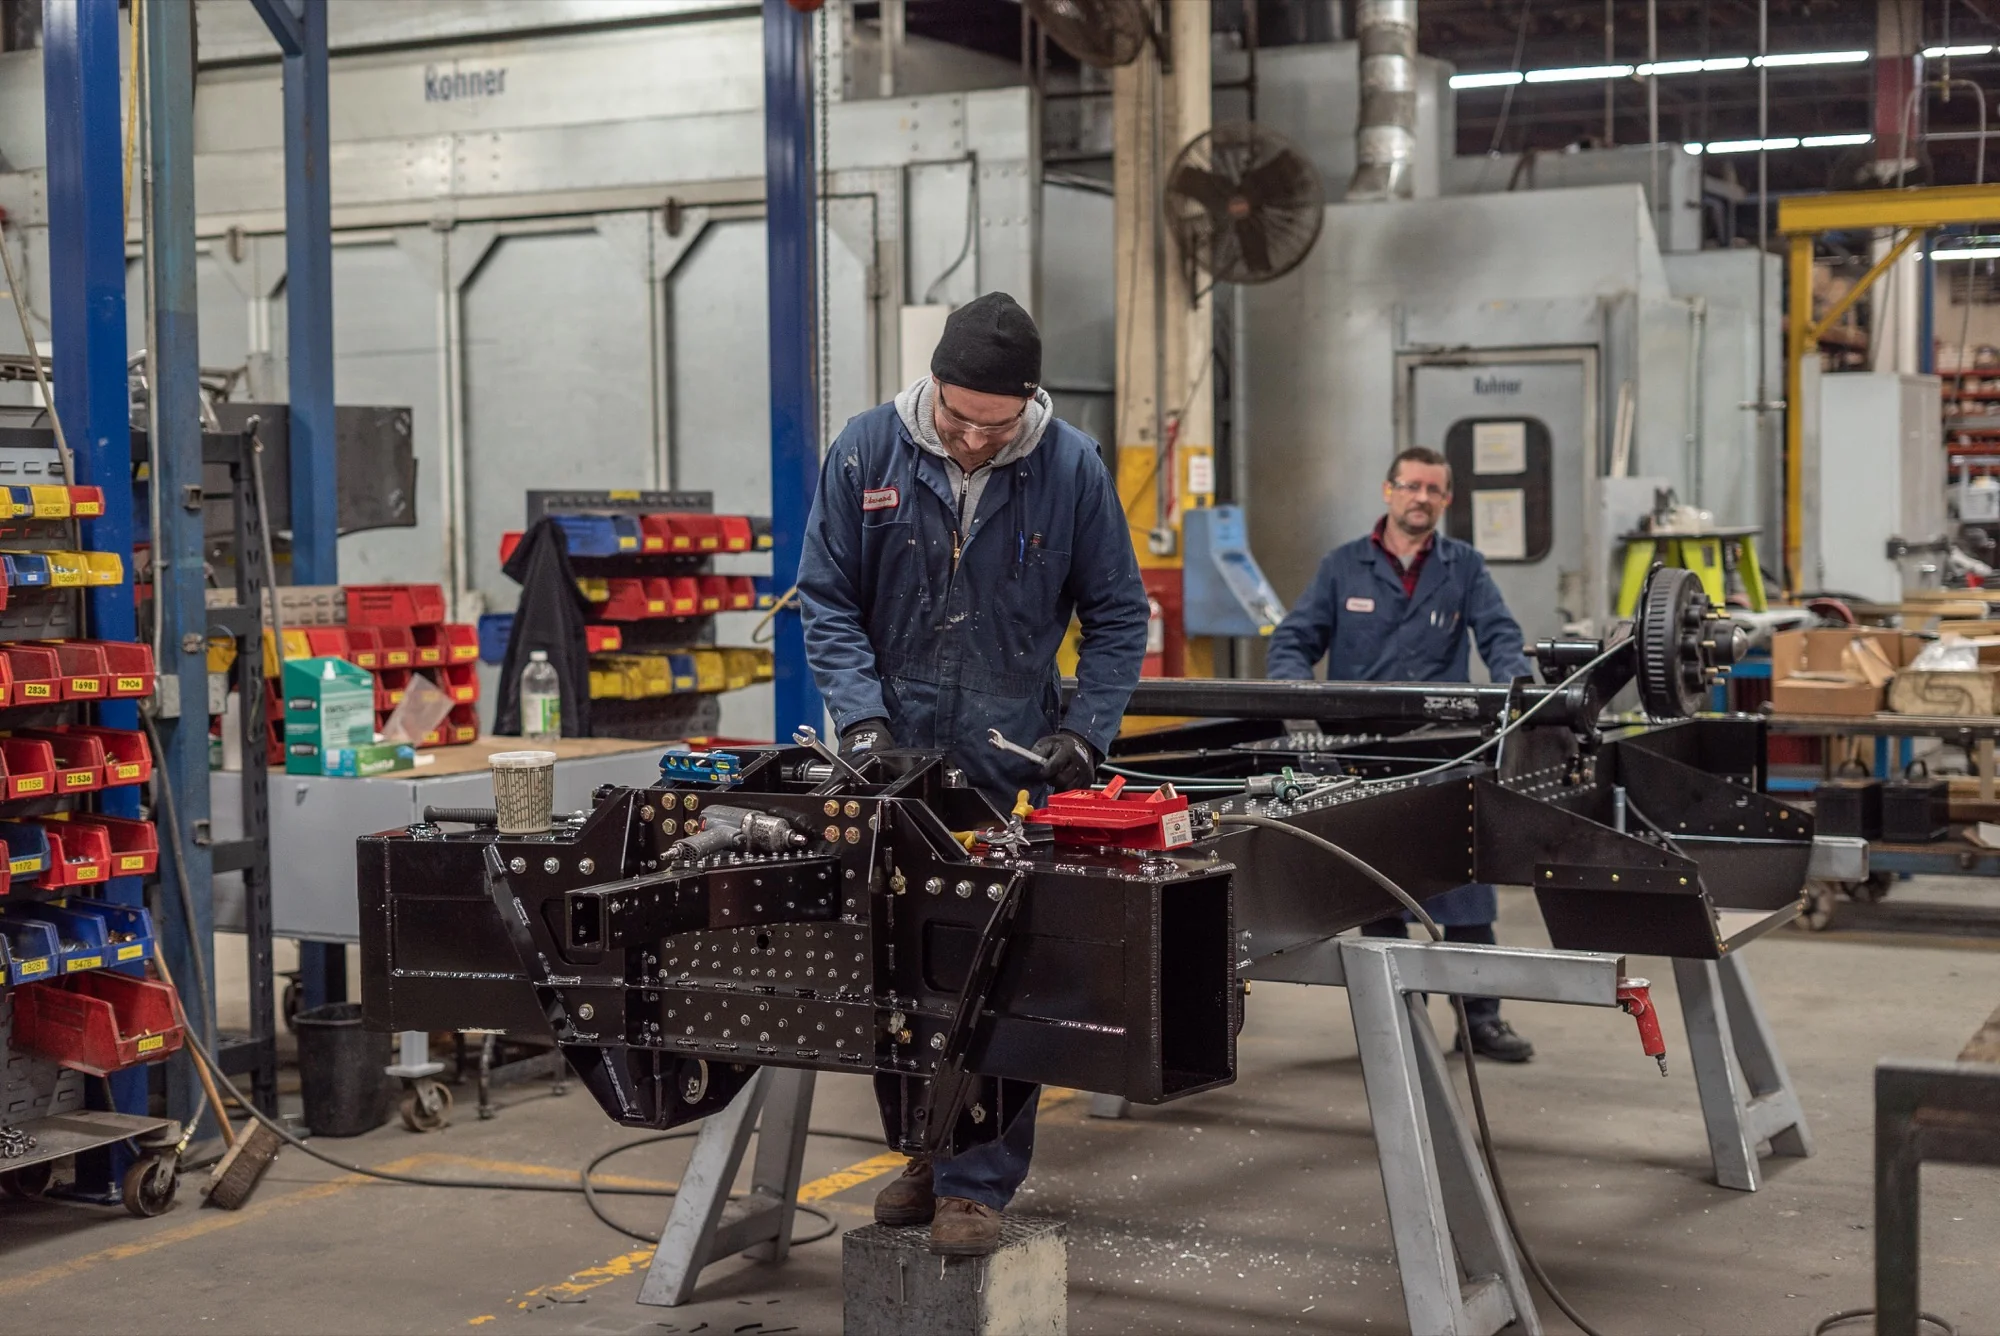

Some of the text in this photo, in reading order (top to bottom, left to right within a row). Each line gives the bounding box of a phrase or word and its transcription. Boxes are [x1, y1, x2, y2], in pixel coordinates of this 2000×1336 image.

[75, 680, 97, 691] 16981
[120, 679, 140, 689] 7906
[27, 685, 47, 695] 2836
[20, 778, 42, 790] 11158
[67, 774, 91, 785] 21536
[14, 860, 32, 871] 1172
[24, 960, 45, 972] 18281
